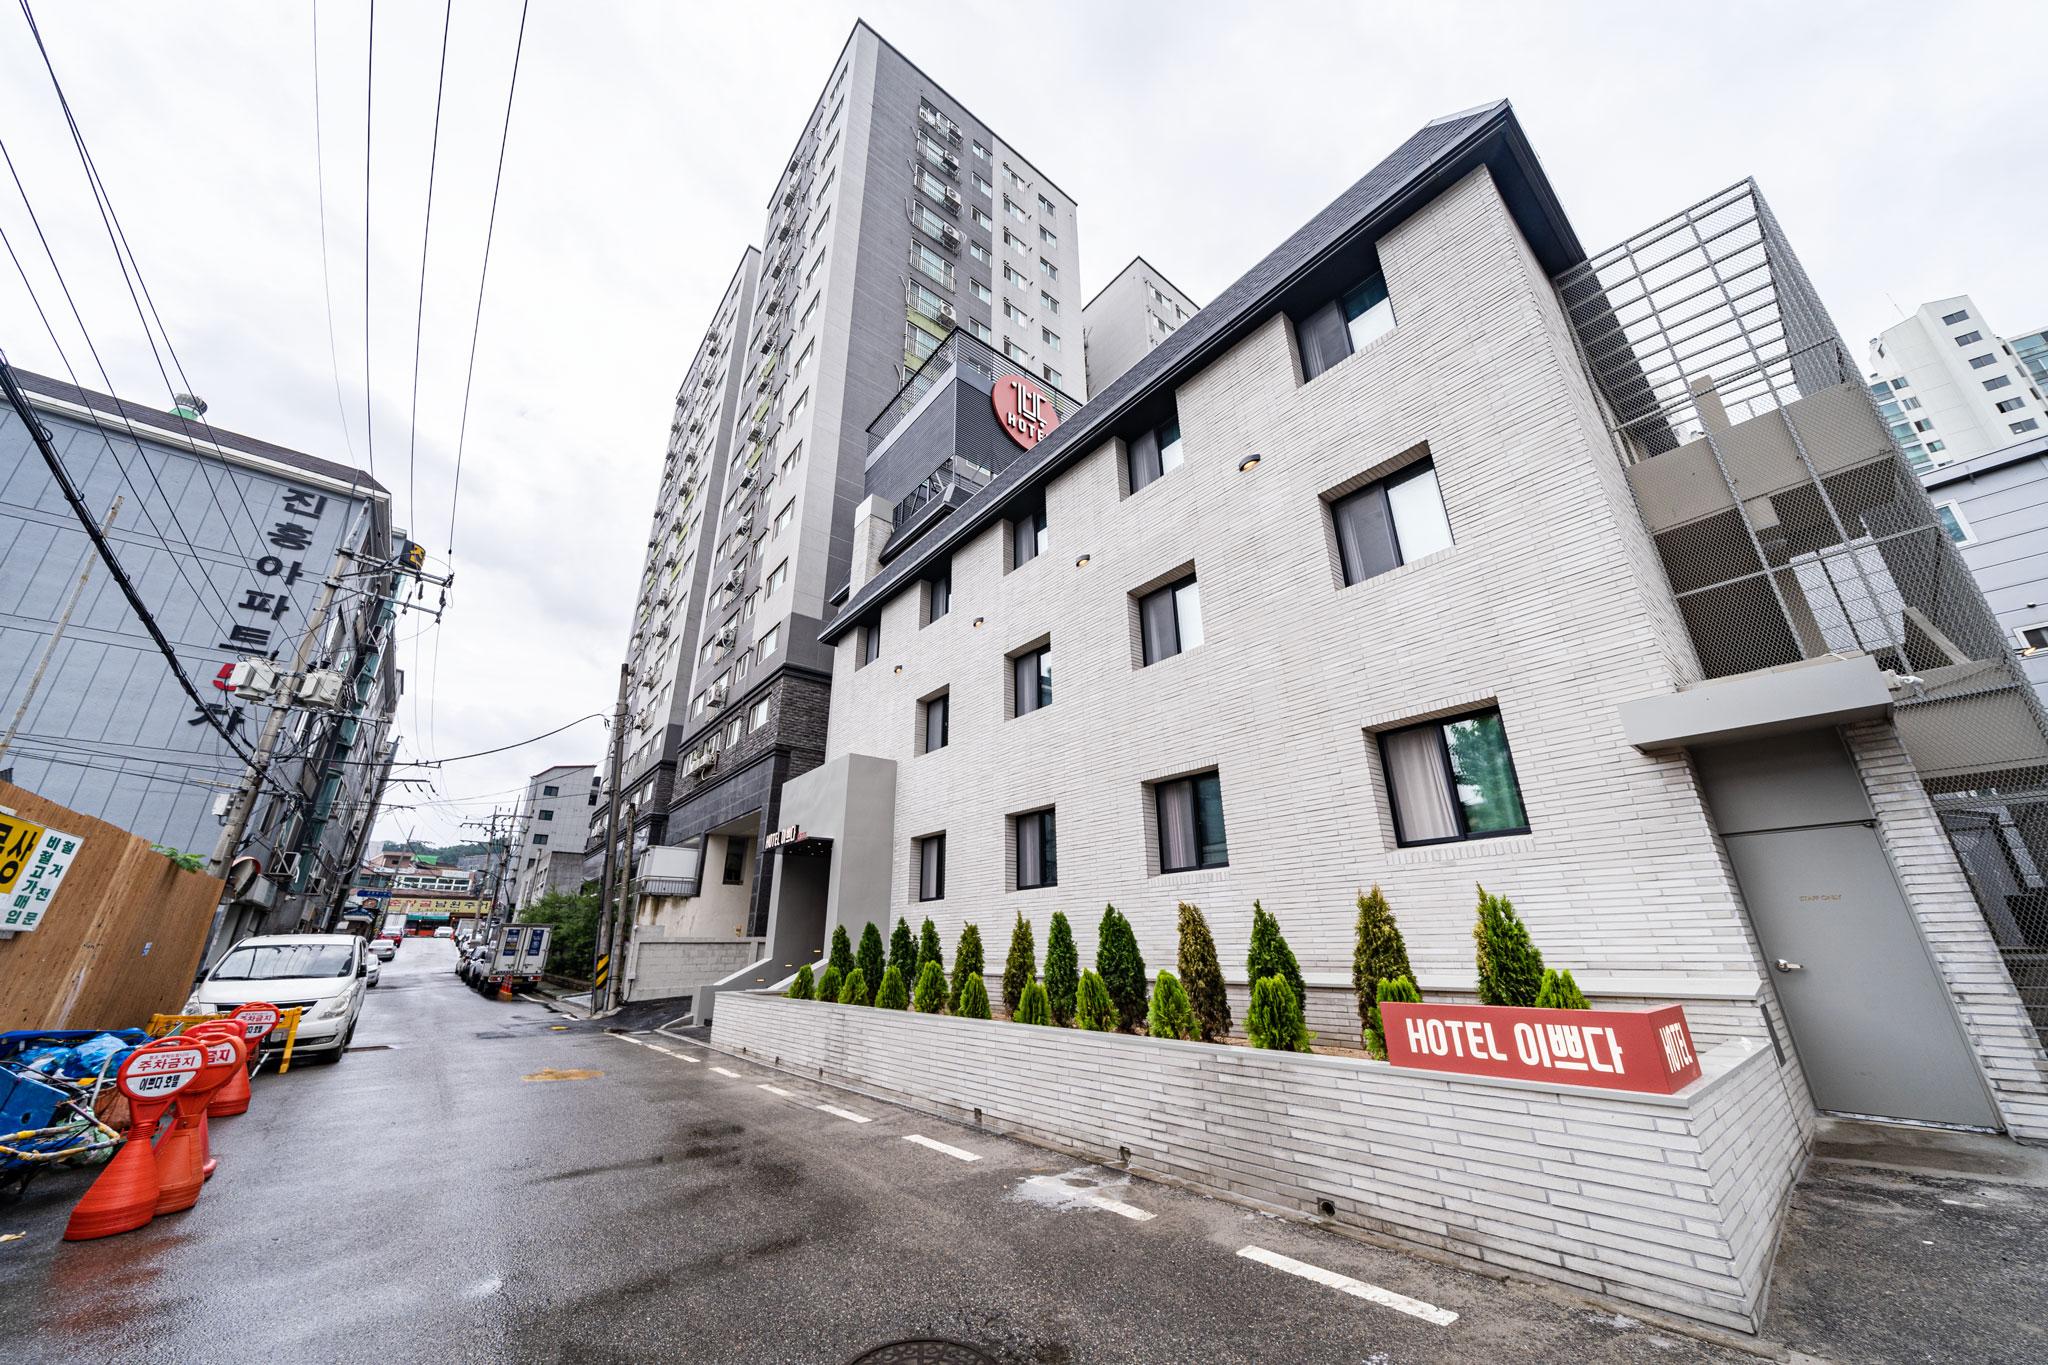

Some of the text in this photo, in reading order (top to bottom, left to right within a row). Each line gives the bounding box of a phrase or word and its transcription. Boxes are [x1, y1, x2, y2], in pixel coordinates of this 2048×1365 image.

[1007, 411, 1048, 442] HOTE
[218, 487, 328, 656] 진흥아파트
[137, 1055, 196, 1072] 주차금지
[1405, 1018, 1626, 1074] HOTEL 이쁘다
[1659, 1022, 1694, 1074] HOTEL
[163, 1074, 181, 1089] 호텔
